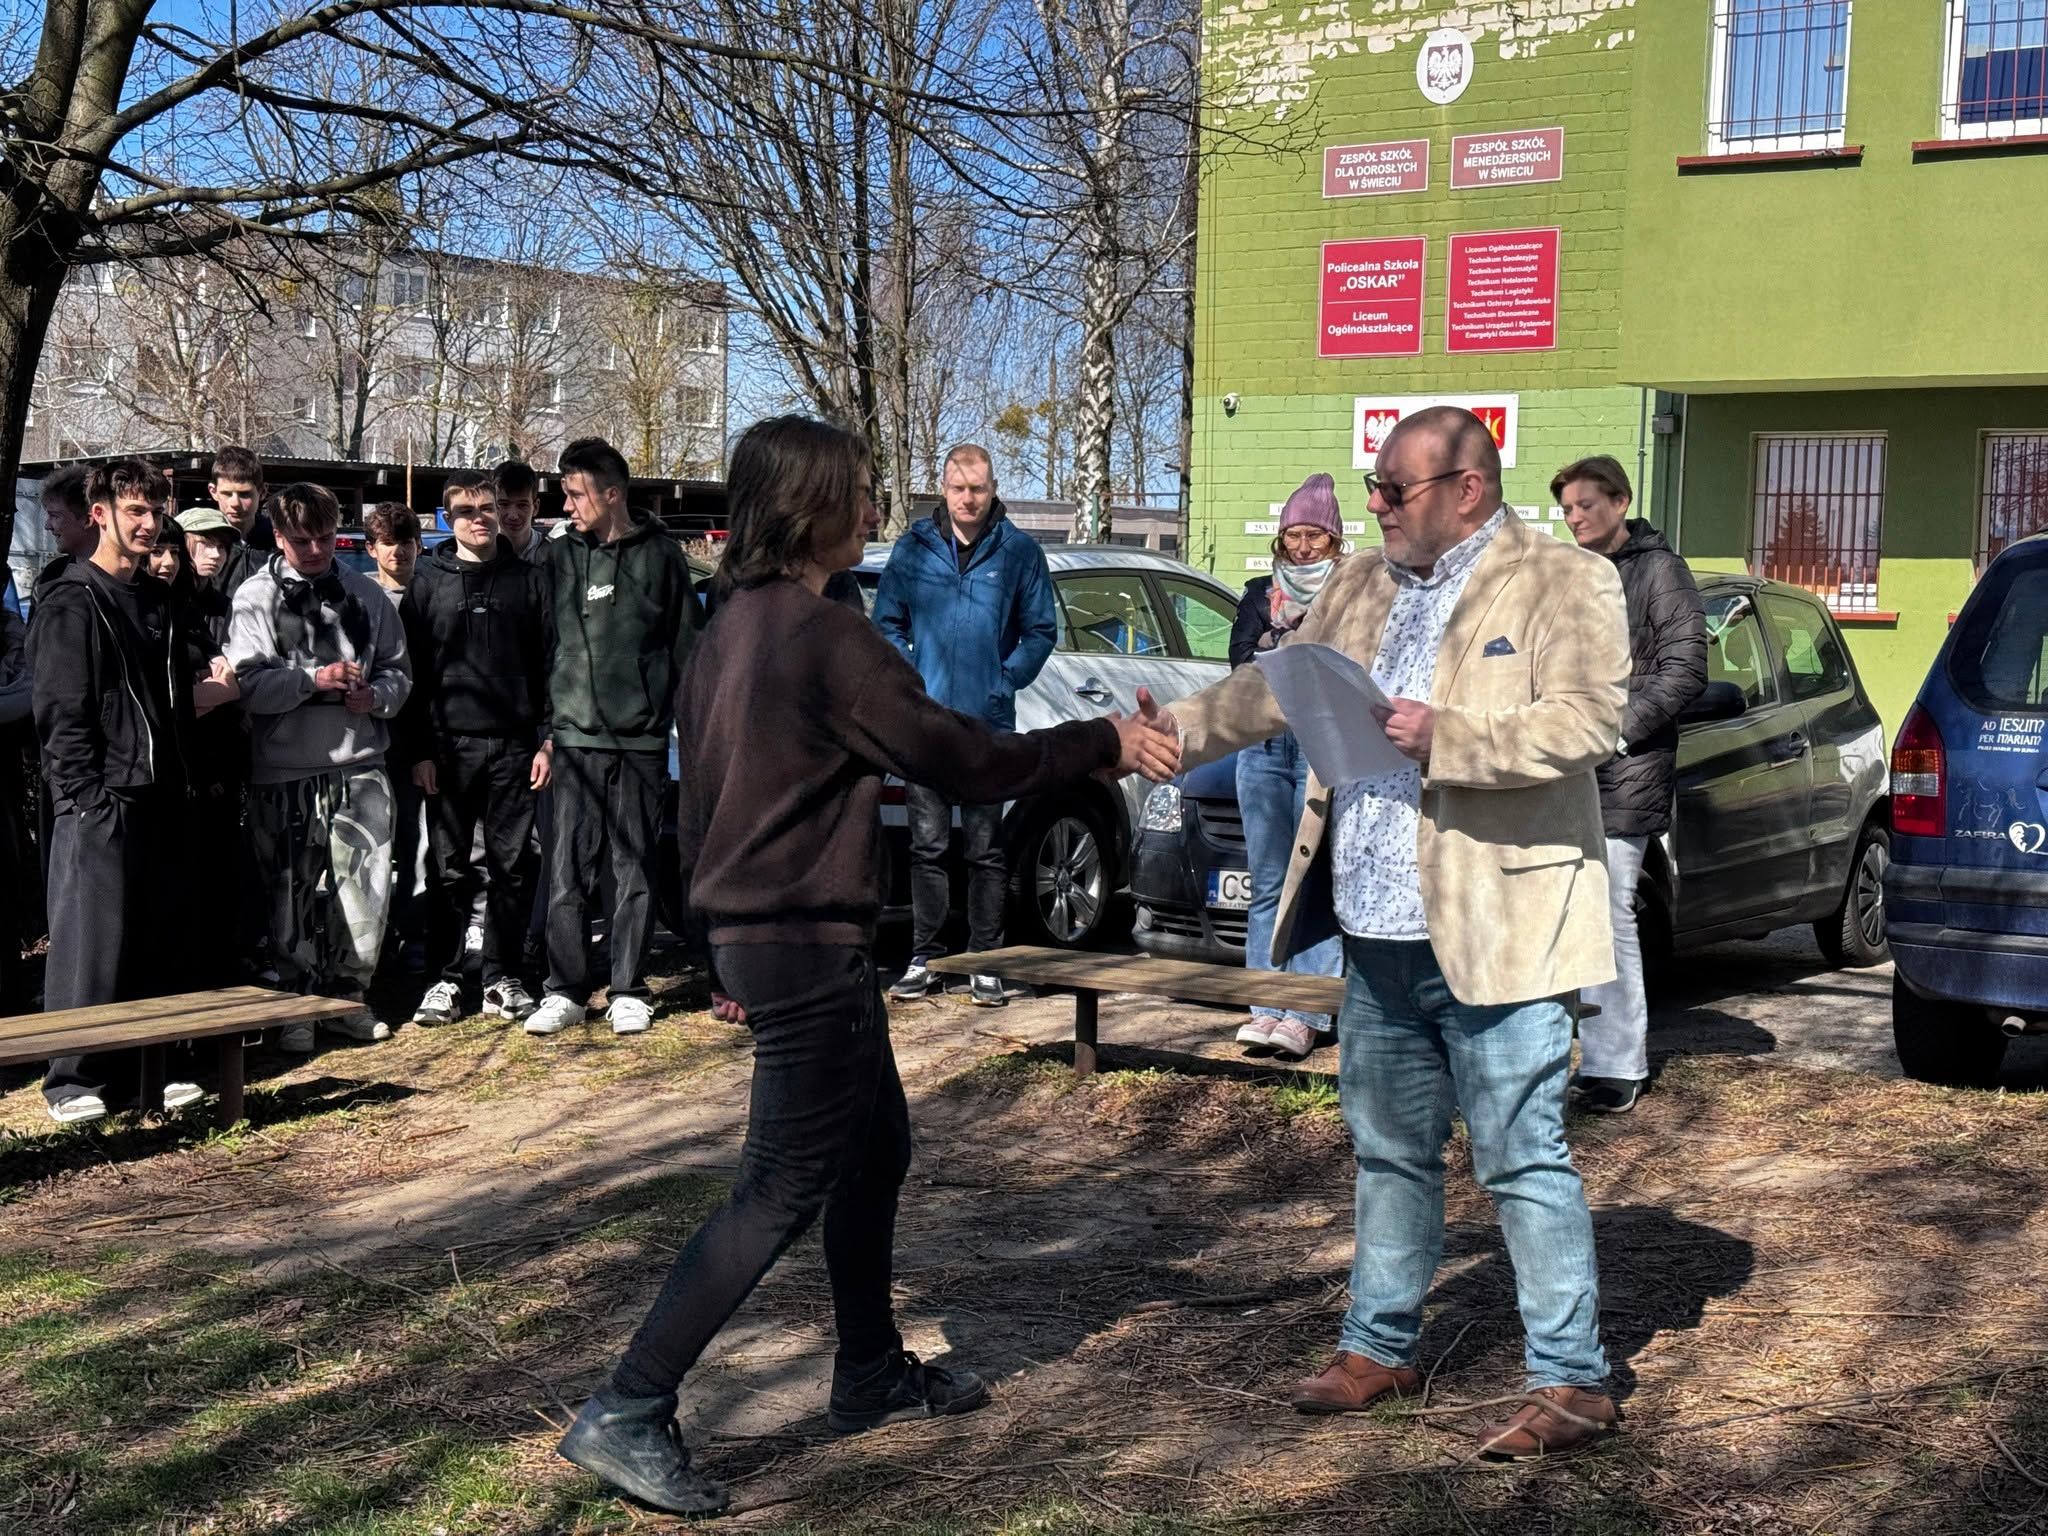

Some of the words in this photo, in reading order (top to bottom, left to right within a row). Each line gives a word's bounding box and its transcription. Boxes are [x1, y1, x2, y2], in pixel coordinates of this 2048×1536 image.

[1469, 139, 1509, 154] ZESPÓŁ
[1511, 136, 1546, 150] SZKÓŁ
[1340, 151, 1378, 164] ZESPÓŁ
[1380, 147, 1413, 161] SZKÓŁ
[1463, 151, 1551, 168] MENEDŻERSKICH
[1335, 167, 1355, 178] DLA
[1356, 162, 1418, 176] DOROSŁYCH
[1478, 169, 1489, 180] W
[1491, 165, 1534, 179] ŚWIECIU
[1349, 180, 1359, 190] W
[1360, 176, 1402, 189] ŚWIECIU
[1327, 262, 1381, 273] Policealna
[1353, 312, 1388, 321] Liceum
[1981, 721, 1997, 731] AD
[2000, 717, 2046, 733] IESUM
[1979, 734, 1995, 743] PER
[1997, 733, 2042, 746] MARIAM
[1954, 829, 2008, 840] ZAFIRA
